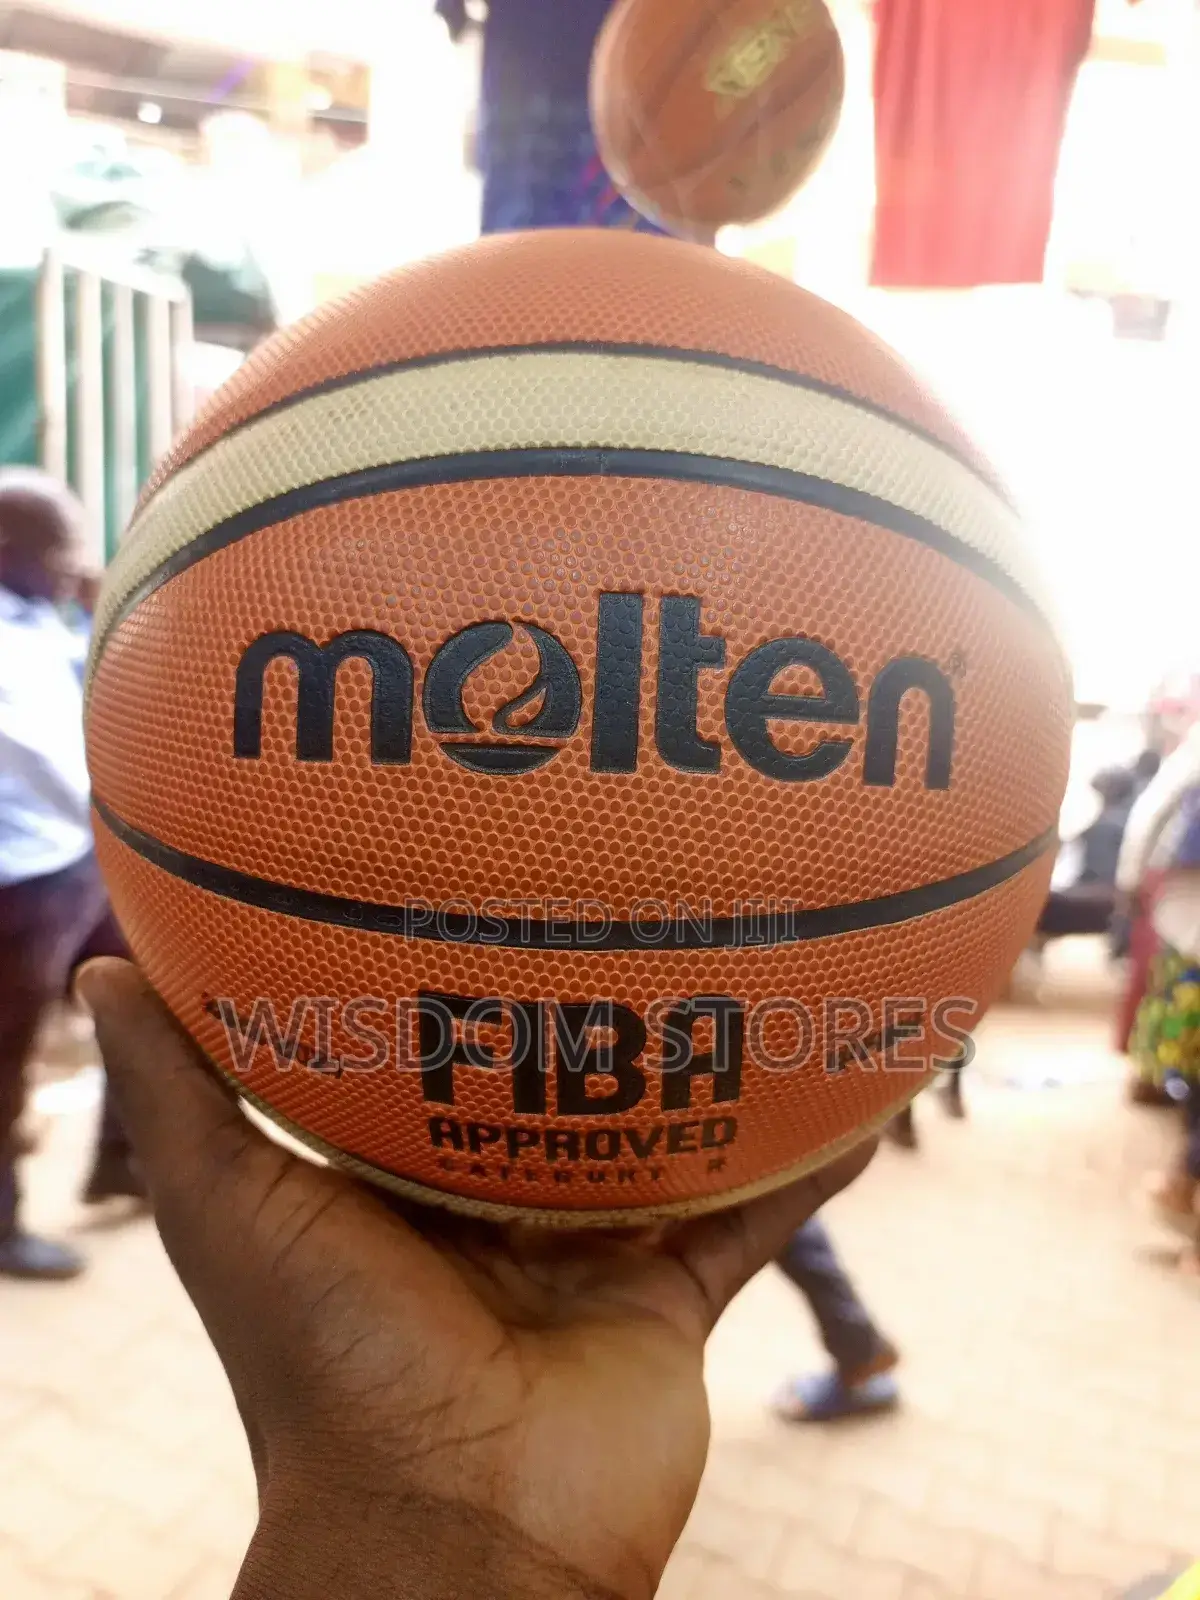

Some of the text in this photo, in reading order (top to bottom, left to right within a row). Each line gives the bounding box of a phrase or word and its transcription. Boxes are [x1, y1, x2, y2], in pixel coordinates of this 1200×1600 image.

[233, 591, 955, 790] molten
[417, 989, 744, 1115] FIBA
[428, 1116, 738, 1161] APPROVED
